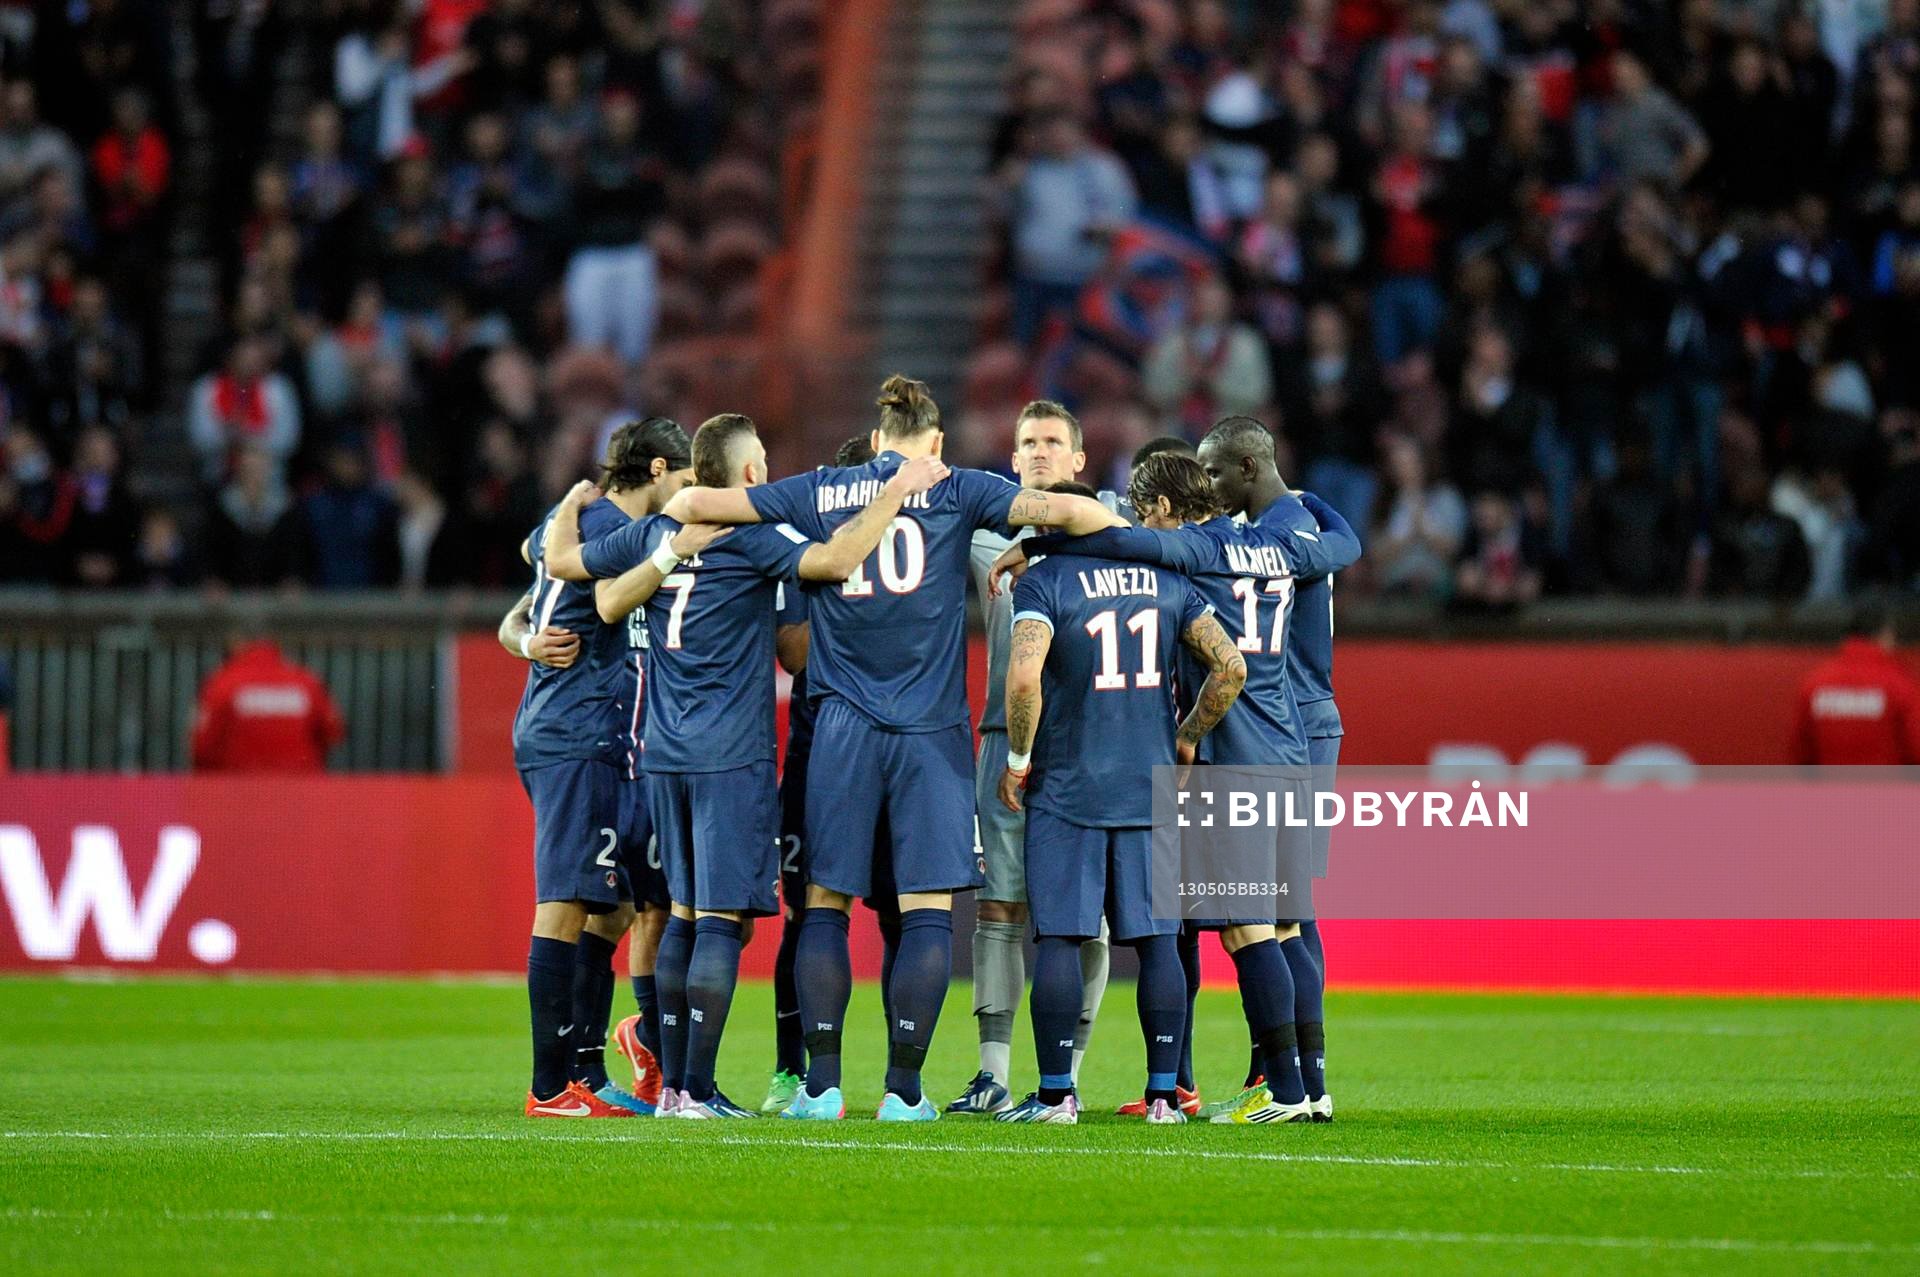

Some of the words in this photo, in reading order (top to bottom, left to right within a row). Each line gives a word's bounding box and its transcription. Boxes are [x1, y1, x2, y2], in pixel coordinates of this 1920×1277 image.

[1078, 567, 1158, 599] LAVEZZI
[660, 572, 696, 649] 7
[1231, 577, 1294, 655] 17
[1084, 607, 1162, 691] 11
[596, 827, 617, 868] 2
[663, 1013, 677, 1026] PSG
[899, 1019, 915, 1031] PSG
[1155, 1035, 1173, 1043] PSG
